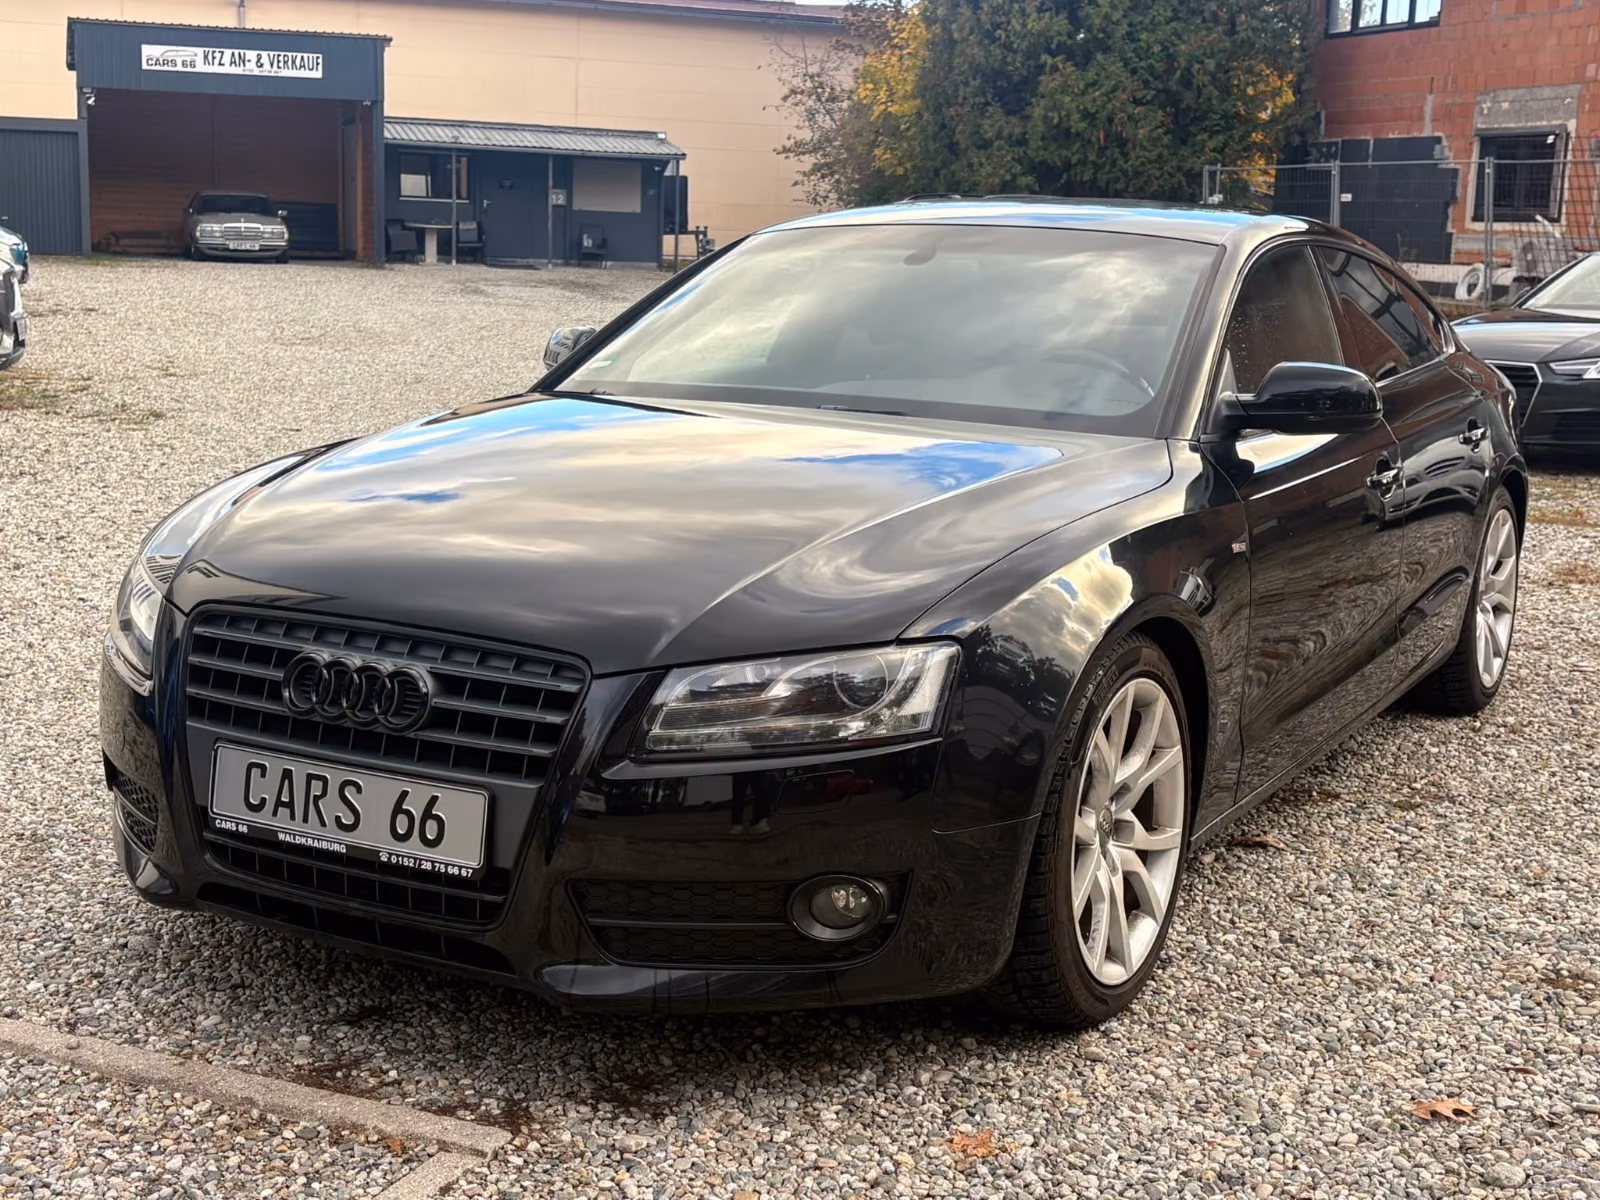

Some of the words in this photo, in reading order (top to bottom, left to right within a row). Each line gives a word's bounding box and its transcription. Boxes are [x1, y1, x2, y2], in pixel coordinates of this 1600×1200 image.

[145, 57, 178, 69] CARS
[181, 58, 197, 69] 66
[203, 49, 225, 67] KFZ
[229, 51, 252, 68] AN-
[255, 53, 264, 69] &
[267, 53, 321, 72] VERKAUF
[551, 194, 564, 205] 12
[243, 759, 364, 833] CARS
[389, 788, 447, 849] 66
[215, 819, 238, 832] CARS
[237, 824, 248, 834] 66
[277, 831, 347, 854] WALDKRAIBURG
[391, 855, 415, 868] 0152
[420, 859, 433, 871] 28
[434, 862, 446, 873] 75
[447, 865, 459, 875] 66
[460, 867, 473, 878] 67
